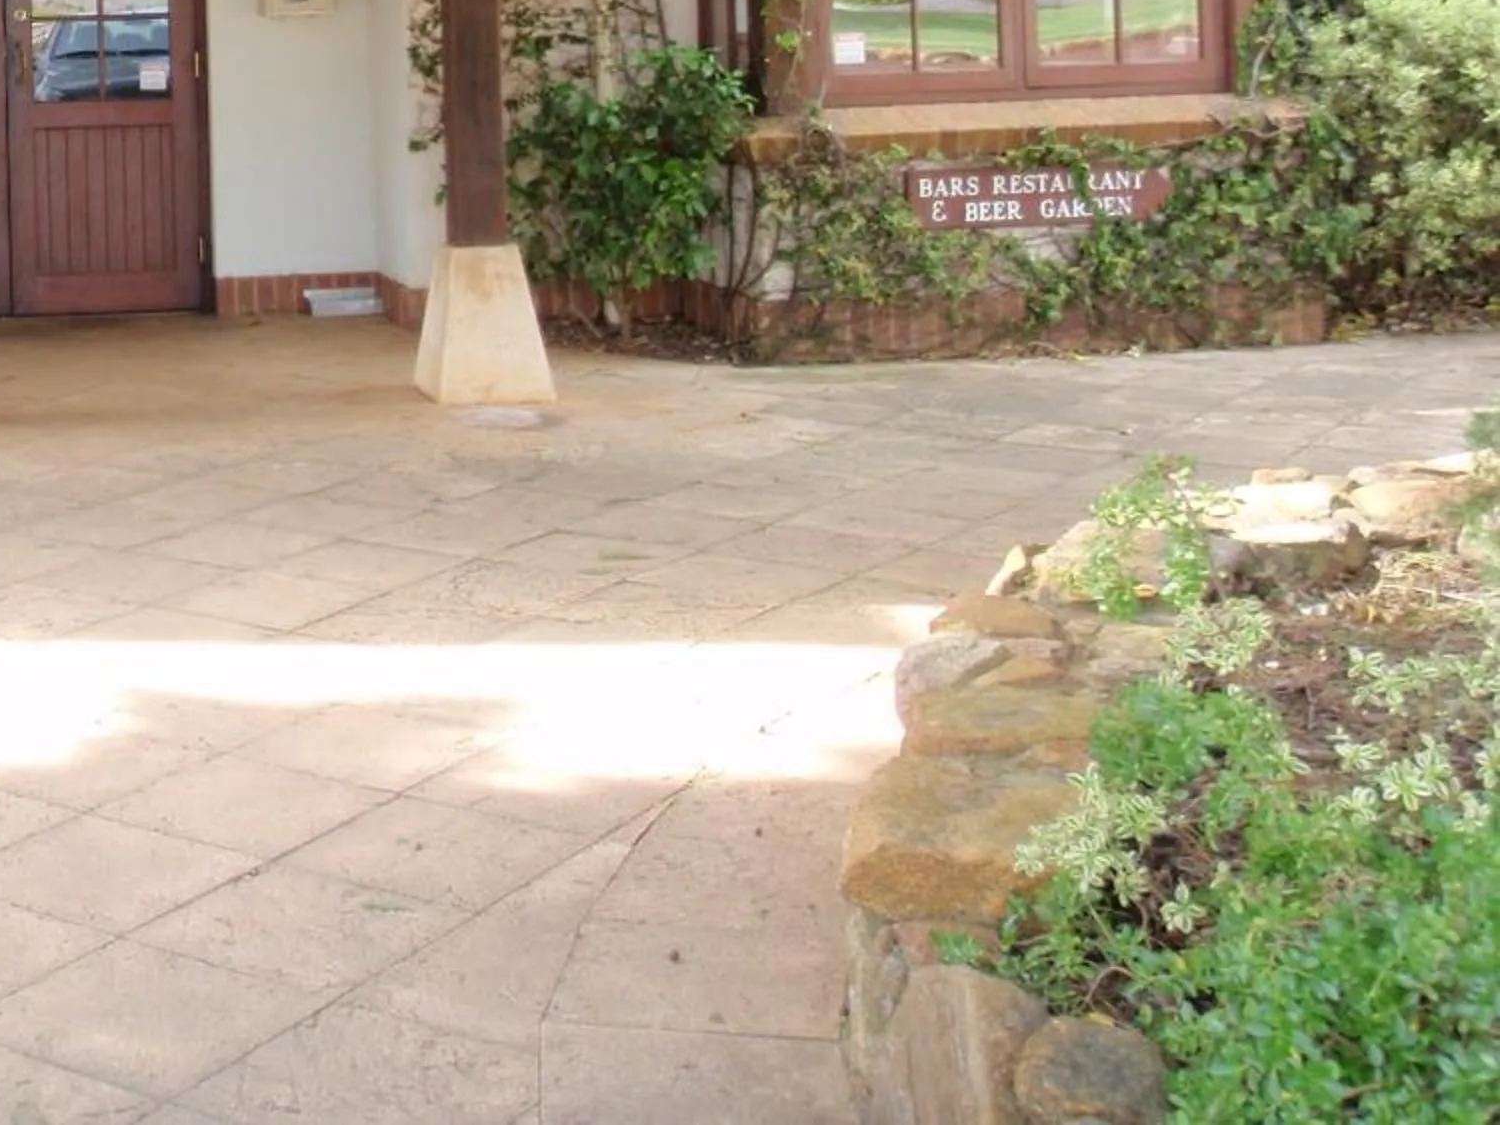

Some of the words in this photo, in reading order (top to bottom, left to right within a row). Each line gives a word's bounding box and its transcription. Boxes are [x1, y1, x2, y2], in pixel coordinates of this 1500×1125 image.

[919, 176, 980, 198] BARS
[932, 199, 947, 222] &
[964, 200, 1023, 222] BEER
